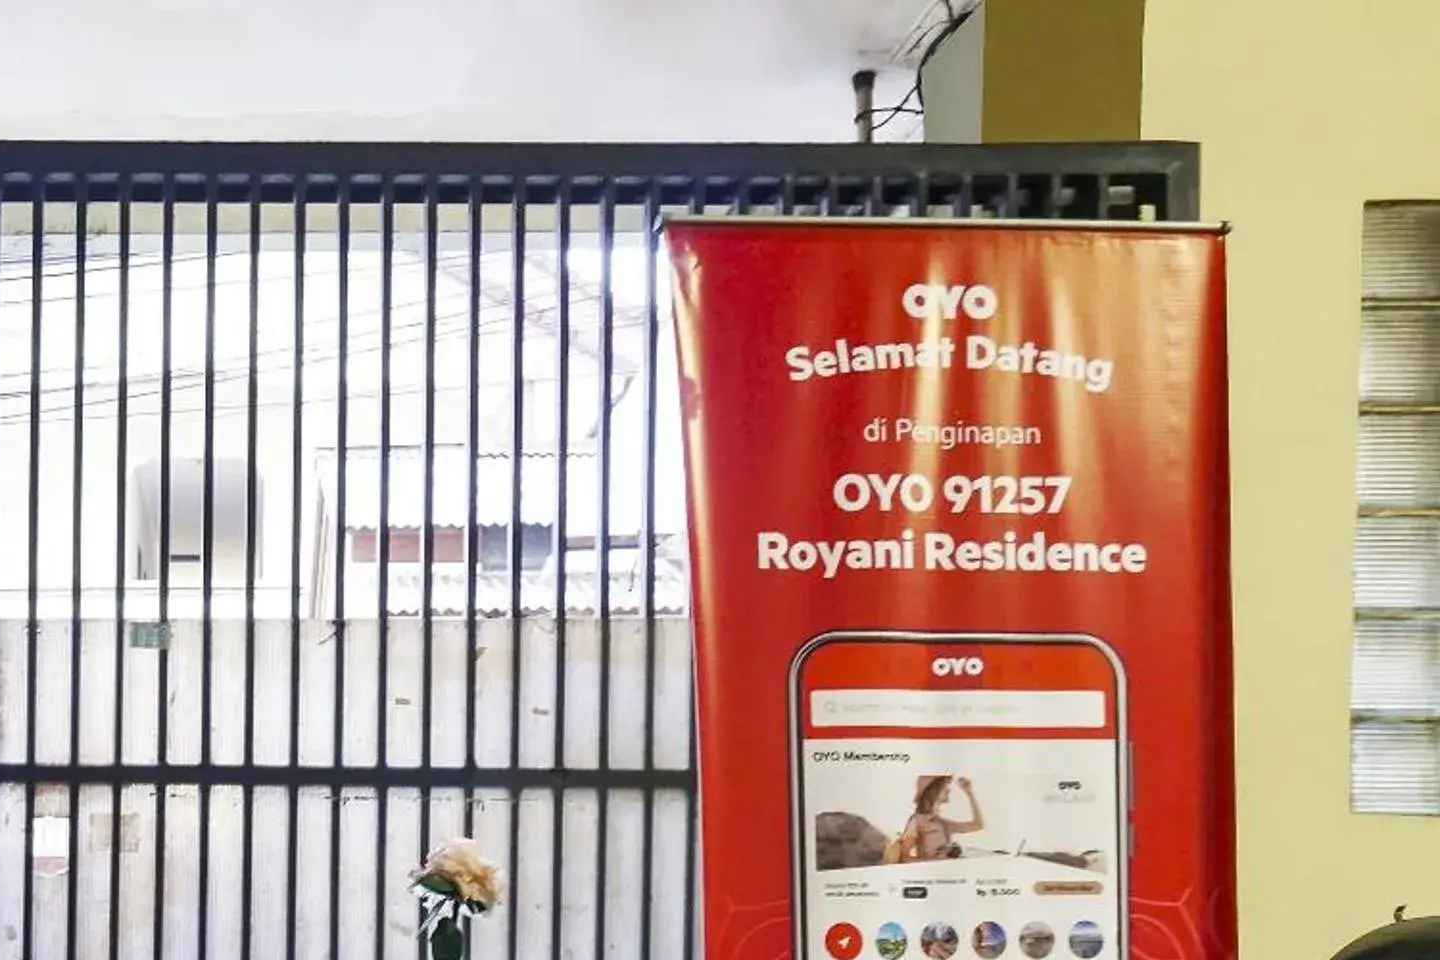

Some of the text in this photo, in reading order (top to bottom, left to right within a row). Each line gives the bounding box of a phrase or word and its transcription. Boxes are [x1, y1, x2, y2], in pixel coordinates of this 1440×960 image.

[903, 284, 997, 319] OYO
[785, 336, 1113, 392] Selamat Datang
[864, 417, 1041, 449] di Penginapan
[833, 474, 1071, 514] OYO 91257
[758, 529, 1147, 578] Royani Residence
[932, 657, 984, 676] OYO
[813, 751, 840, 762] OYO
